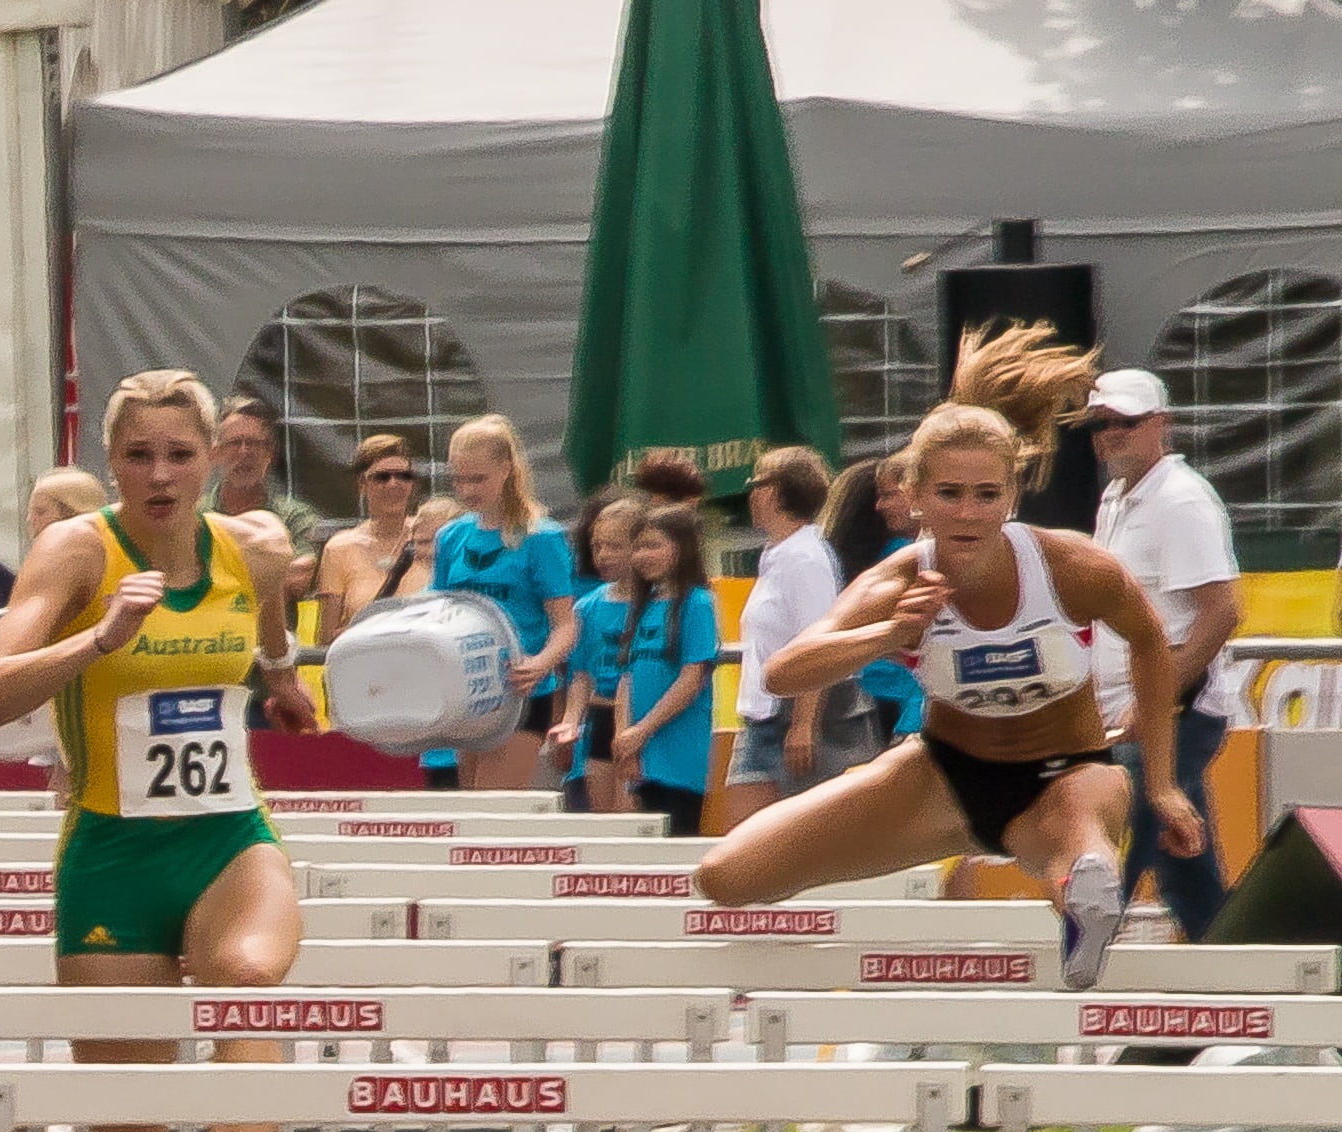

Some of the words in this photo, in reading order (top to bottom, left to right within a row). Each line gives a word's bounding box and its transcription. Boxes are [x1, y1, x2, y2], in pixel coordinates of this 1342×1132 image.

[132, 631, 245, 655] Australia
[146, 740, 231, 799] 262
[555, 876, 688, 896] BAUHAUS
[686, 911, 834, 932] BAUHAUS
[862, 957, 1029, 981] BAUHAUS
[196, 1004, 379, 1028] BAUHAUS
[1082, 1008, 1270, 1034] BAUHAUS
[351, 1081, 563, 1108] BAUHAUS
